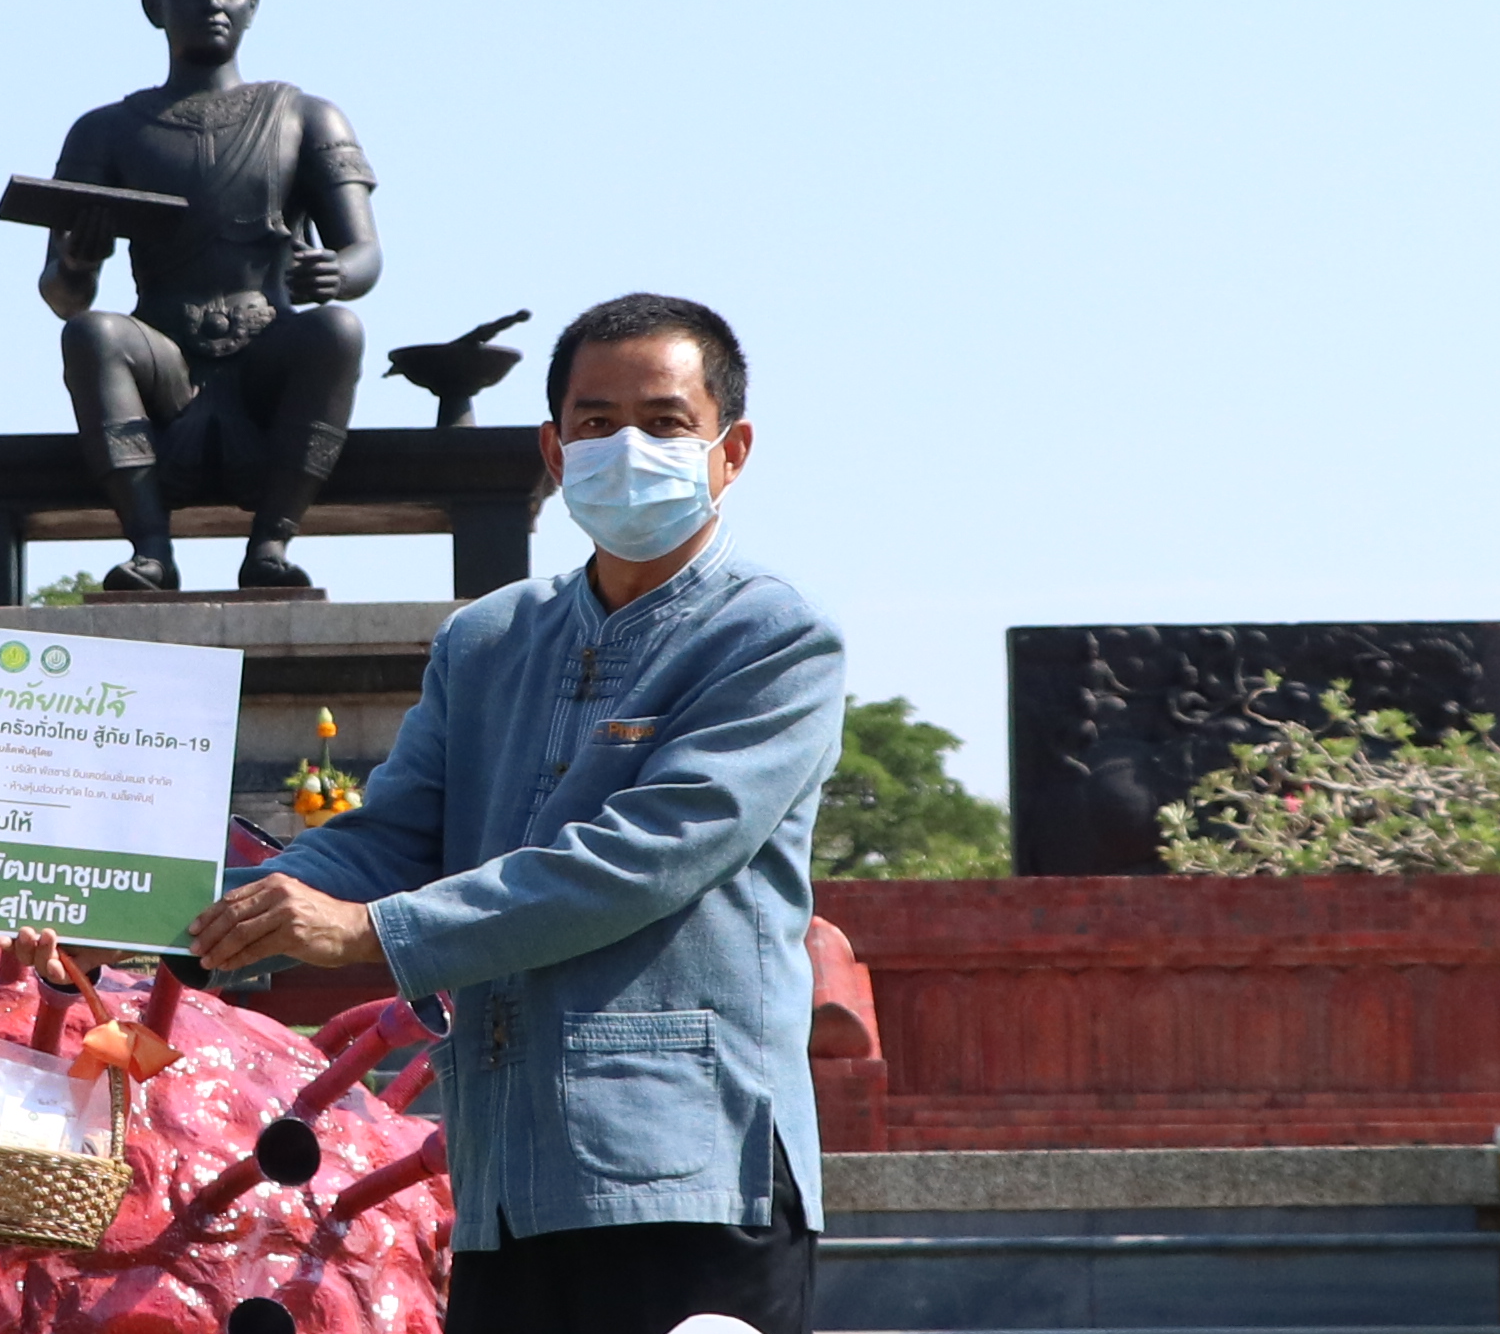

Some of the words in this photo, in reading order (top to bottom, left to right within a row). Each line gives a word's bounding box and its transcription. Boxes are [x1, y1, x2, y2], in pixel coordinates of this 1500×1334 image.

[93, 725, 130, 748] สู้ภัย
[135, 729, 211, 752] โควิด-19
